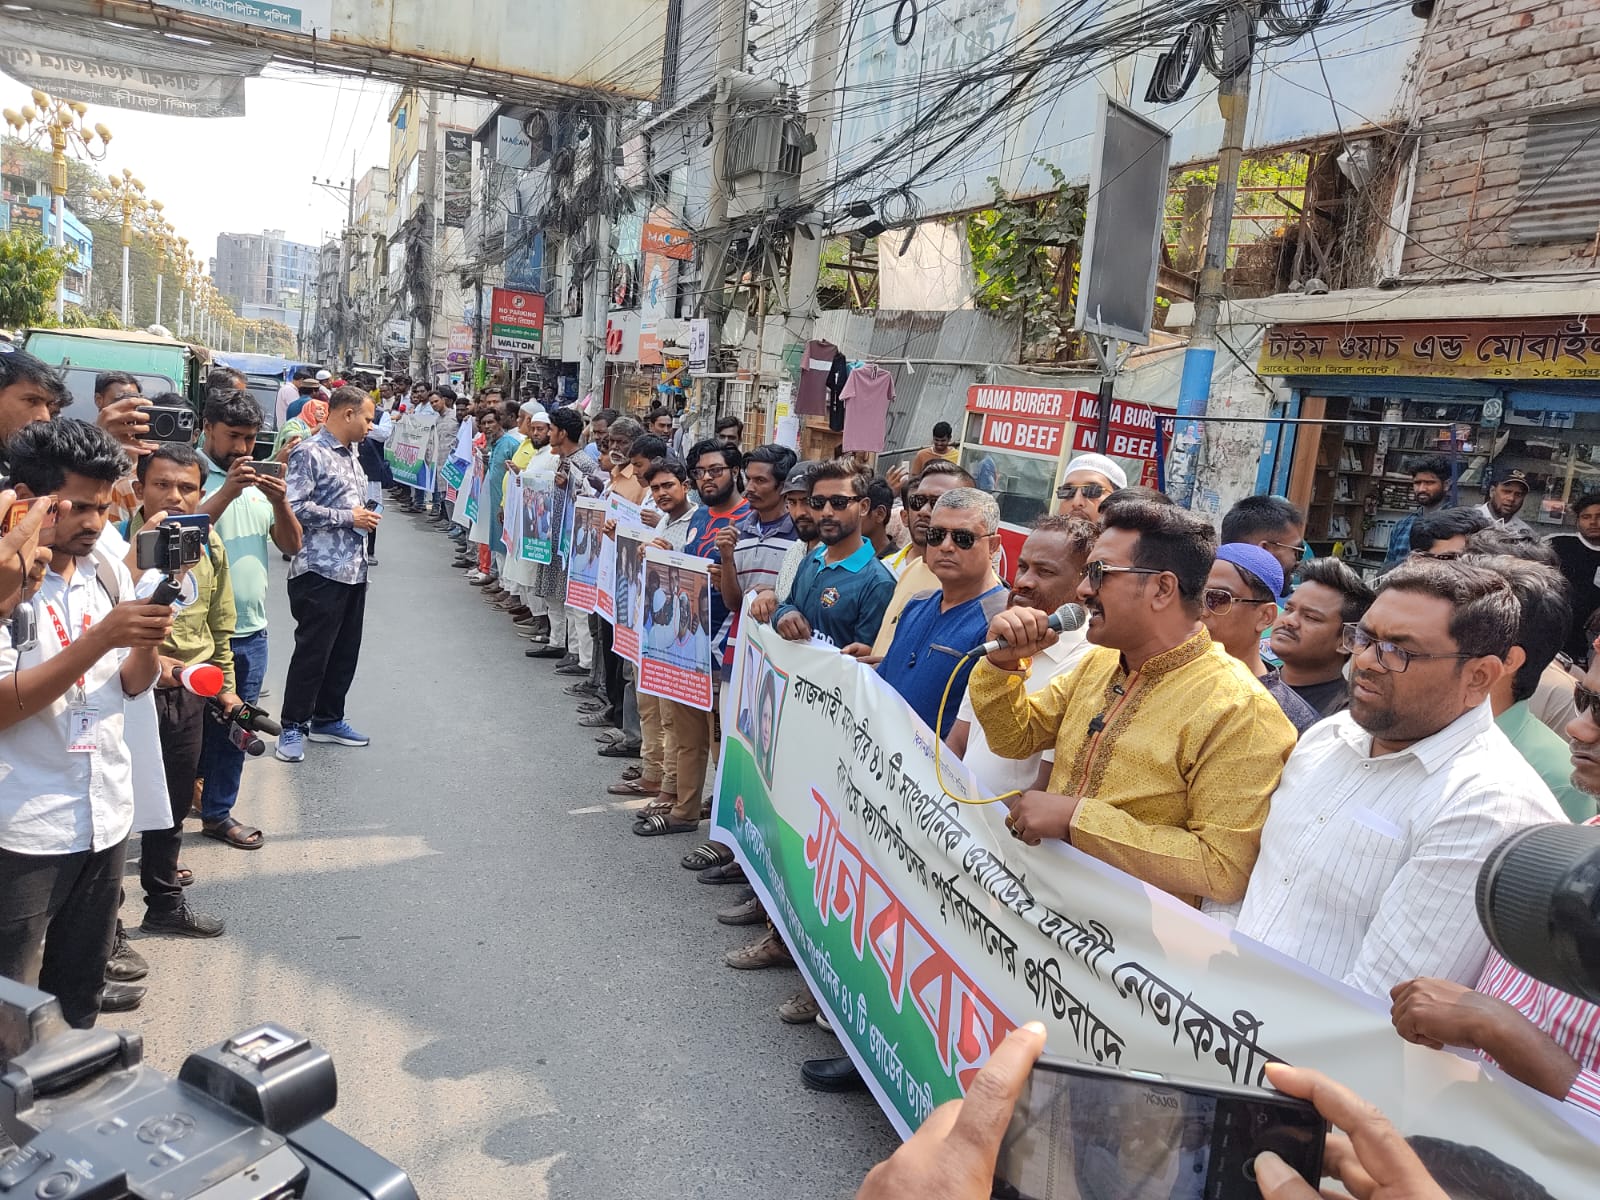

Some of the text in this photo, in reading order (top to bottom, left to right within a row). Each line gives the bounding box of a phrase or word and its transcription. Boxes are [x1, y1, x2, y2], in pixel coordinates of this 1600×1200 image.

[509, 309, 537, 318] PARKING
[498, 339, 535, 350] WALTON
[1269, 330, 1329, 363] টাইম
[1338, 331, 1404, 361] ওয়াচ
[976, 388, 1063, 416] MAMA BURGER
[1079, 398, 1121, 424] MAA
[989, 420, 1060, 450] NO BEEF
[794, 674, 843, 726] রাজশাহী
[869, 745, 884, 782] ৪১
[886, 752, 903, 791] টি
[899, 773, 971, 852] সাংগঠনিক
[1112, 961, 1292, 1089] নেতাকর্মী
[1024, 957, 1126, 1065] প্রতিবাদে
